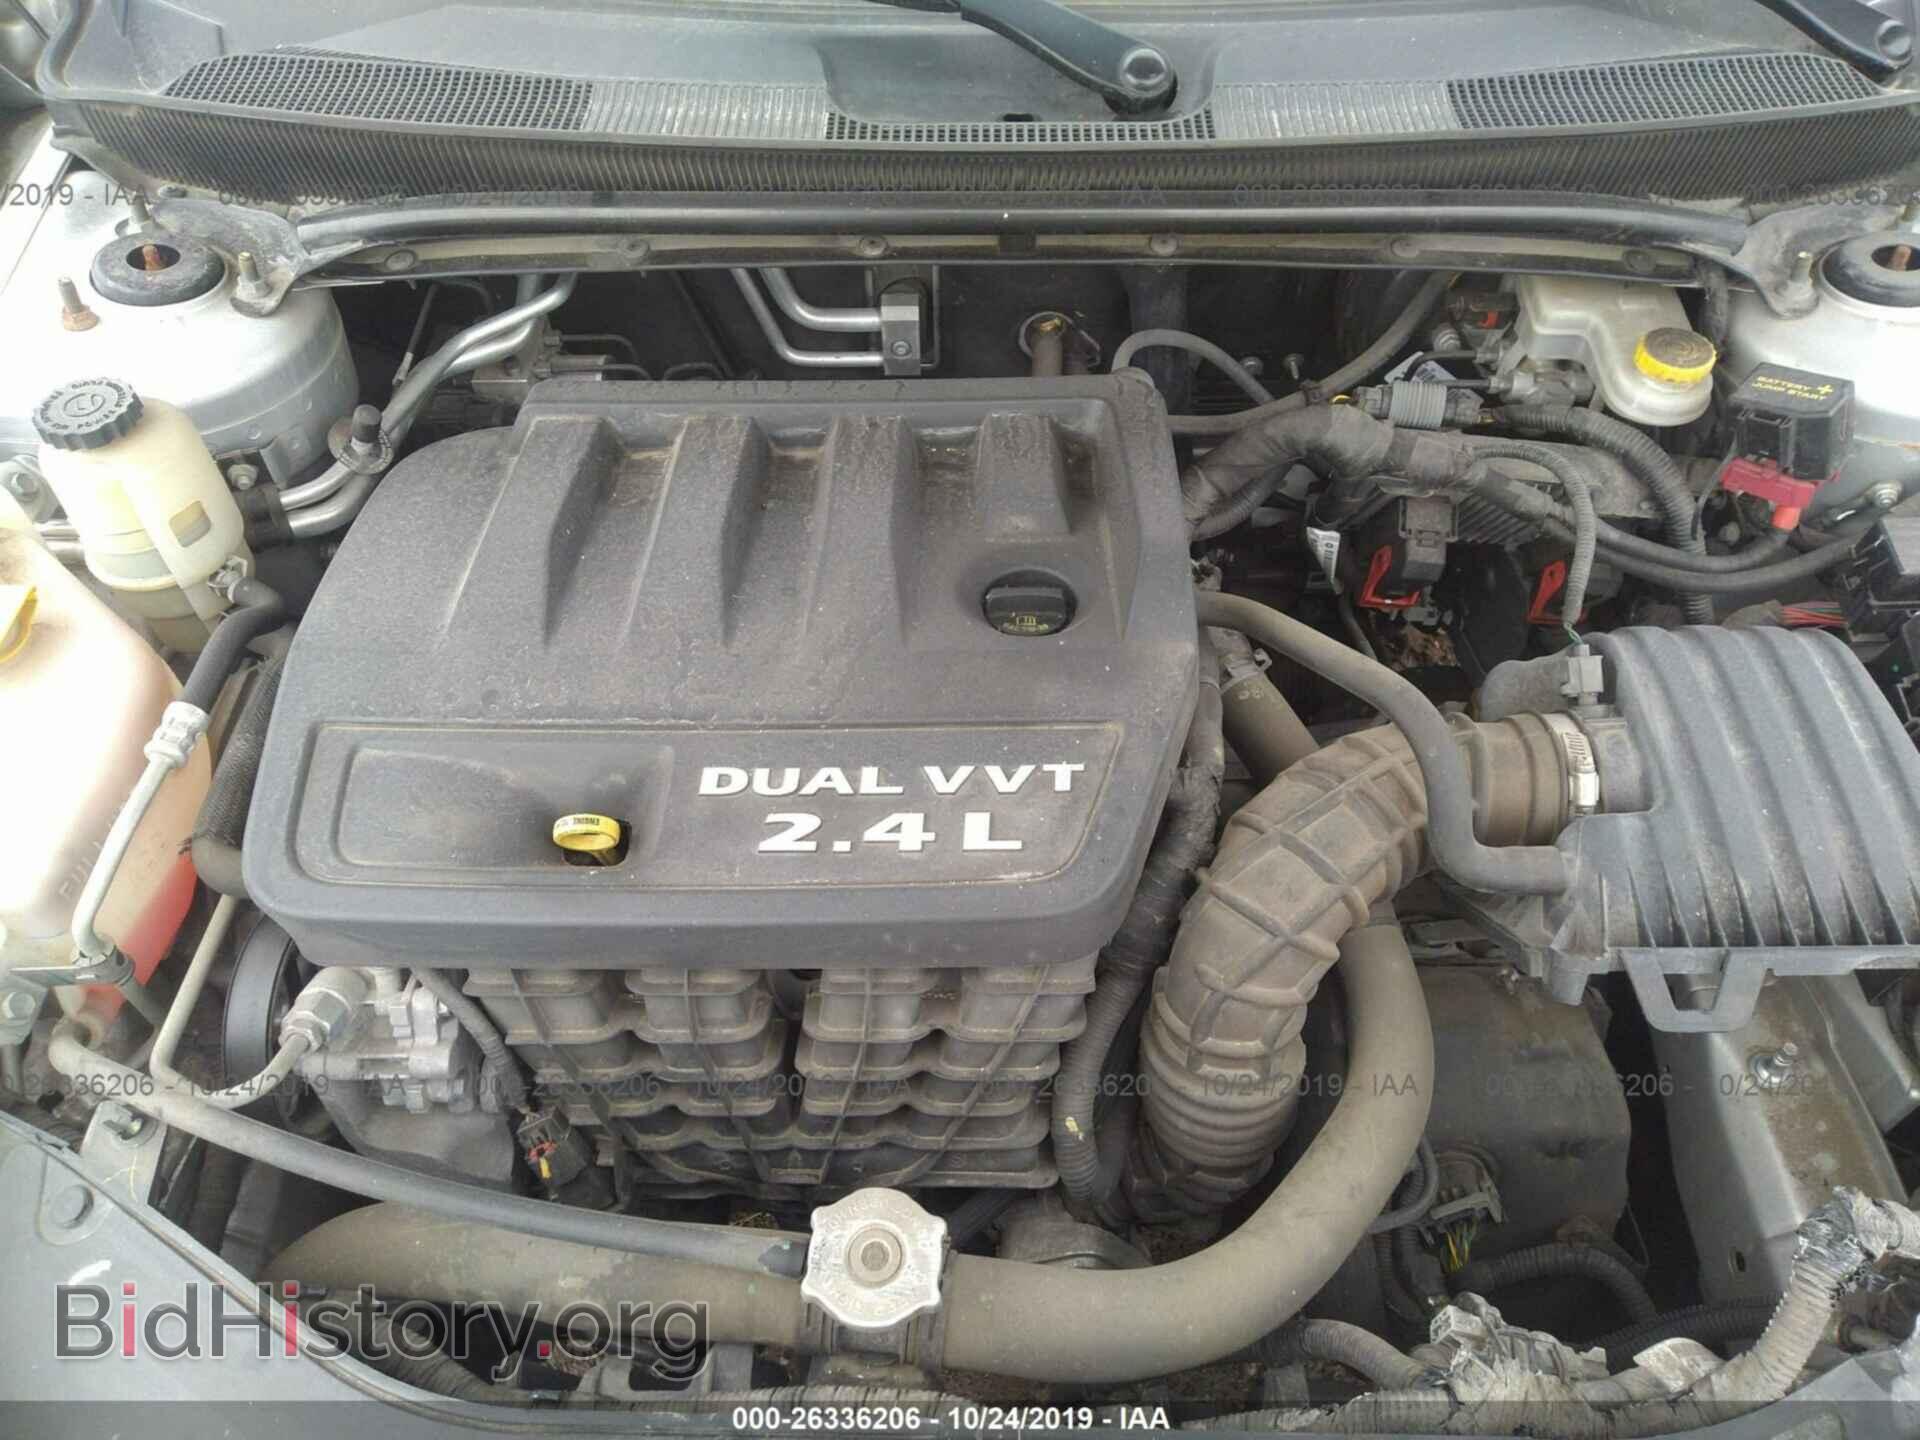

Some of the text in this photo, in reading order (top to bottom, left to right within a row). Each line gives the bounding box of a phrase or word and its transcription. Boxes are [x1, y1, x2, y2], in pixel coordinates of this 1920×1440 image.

[1786, 388, 1828, 401] START
[698, 763, 1086, 796] DUAL VVT
